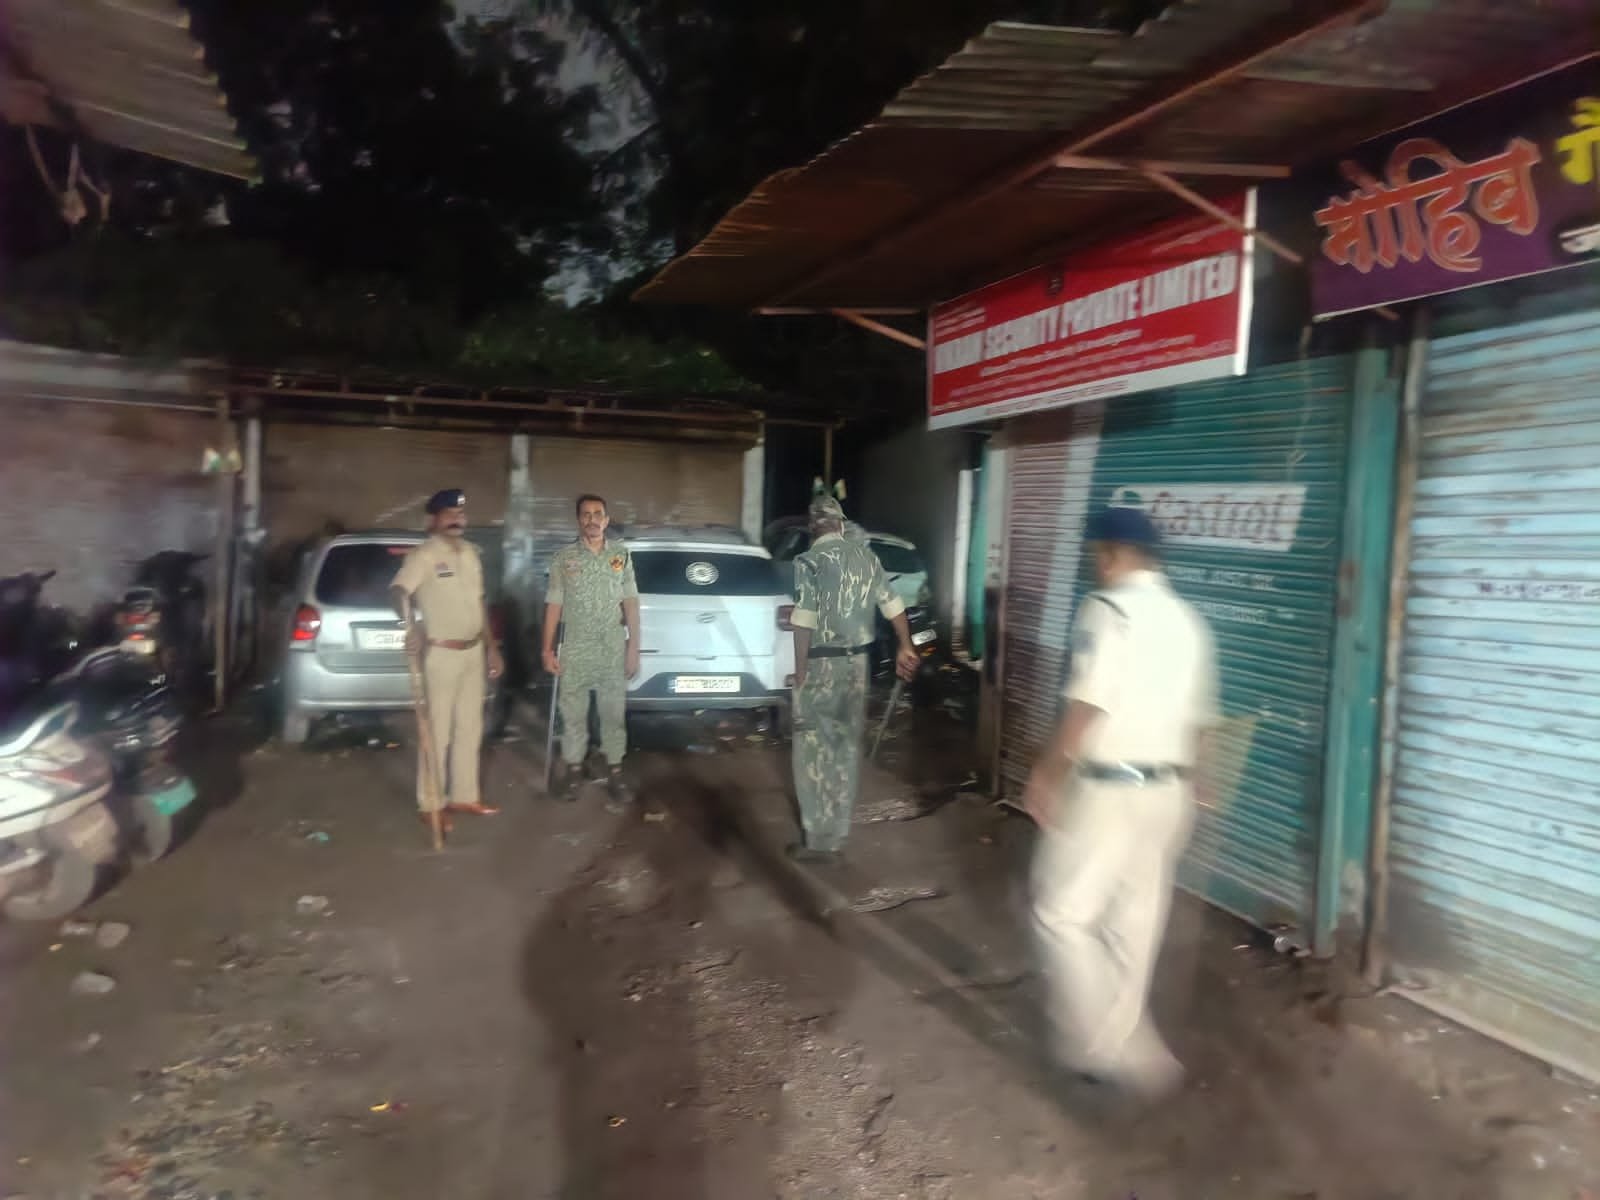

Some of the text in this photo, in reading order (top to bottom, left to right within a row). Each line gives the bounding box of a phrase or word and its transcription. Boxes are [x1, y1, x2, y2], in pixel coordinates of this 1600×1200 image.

[984, 304, 1061, 361] SECURITY
[1059, 278, 1141, 339] PRIVATE
[1141, 252, 1238, 317] LIMITED
